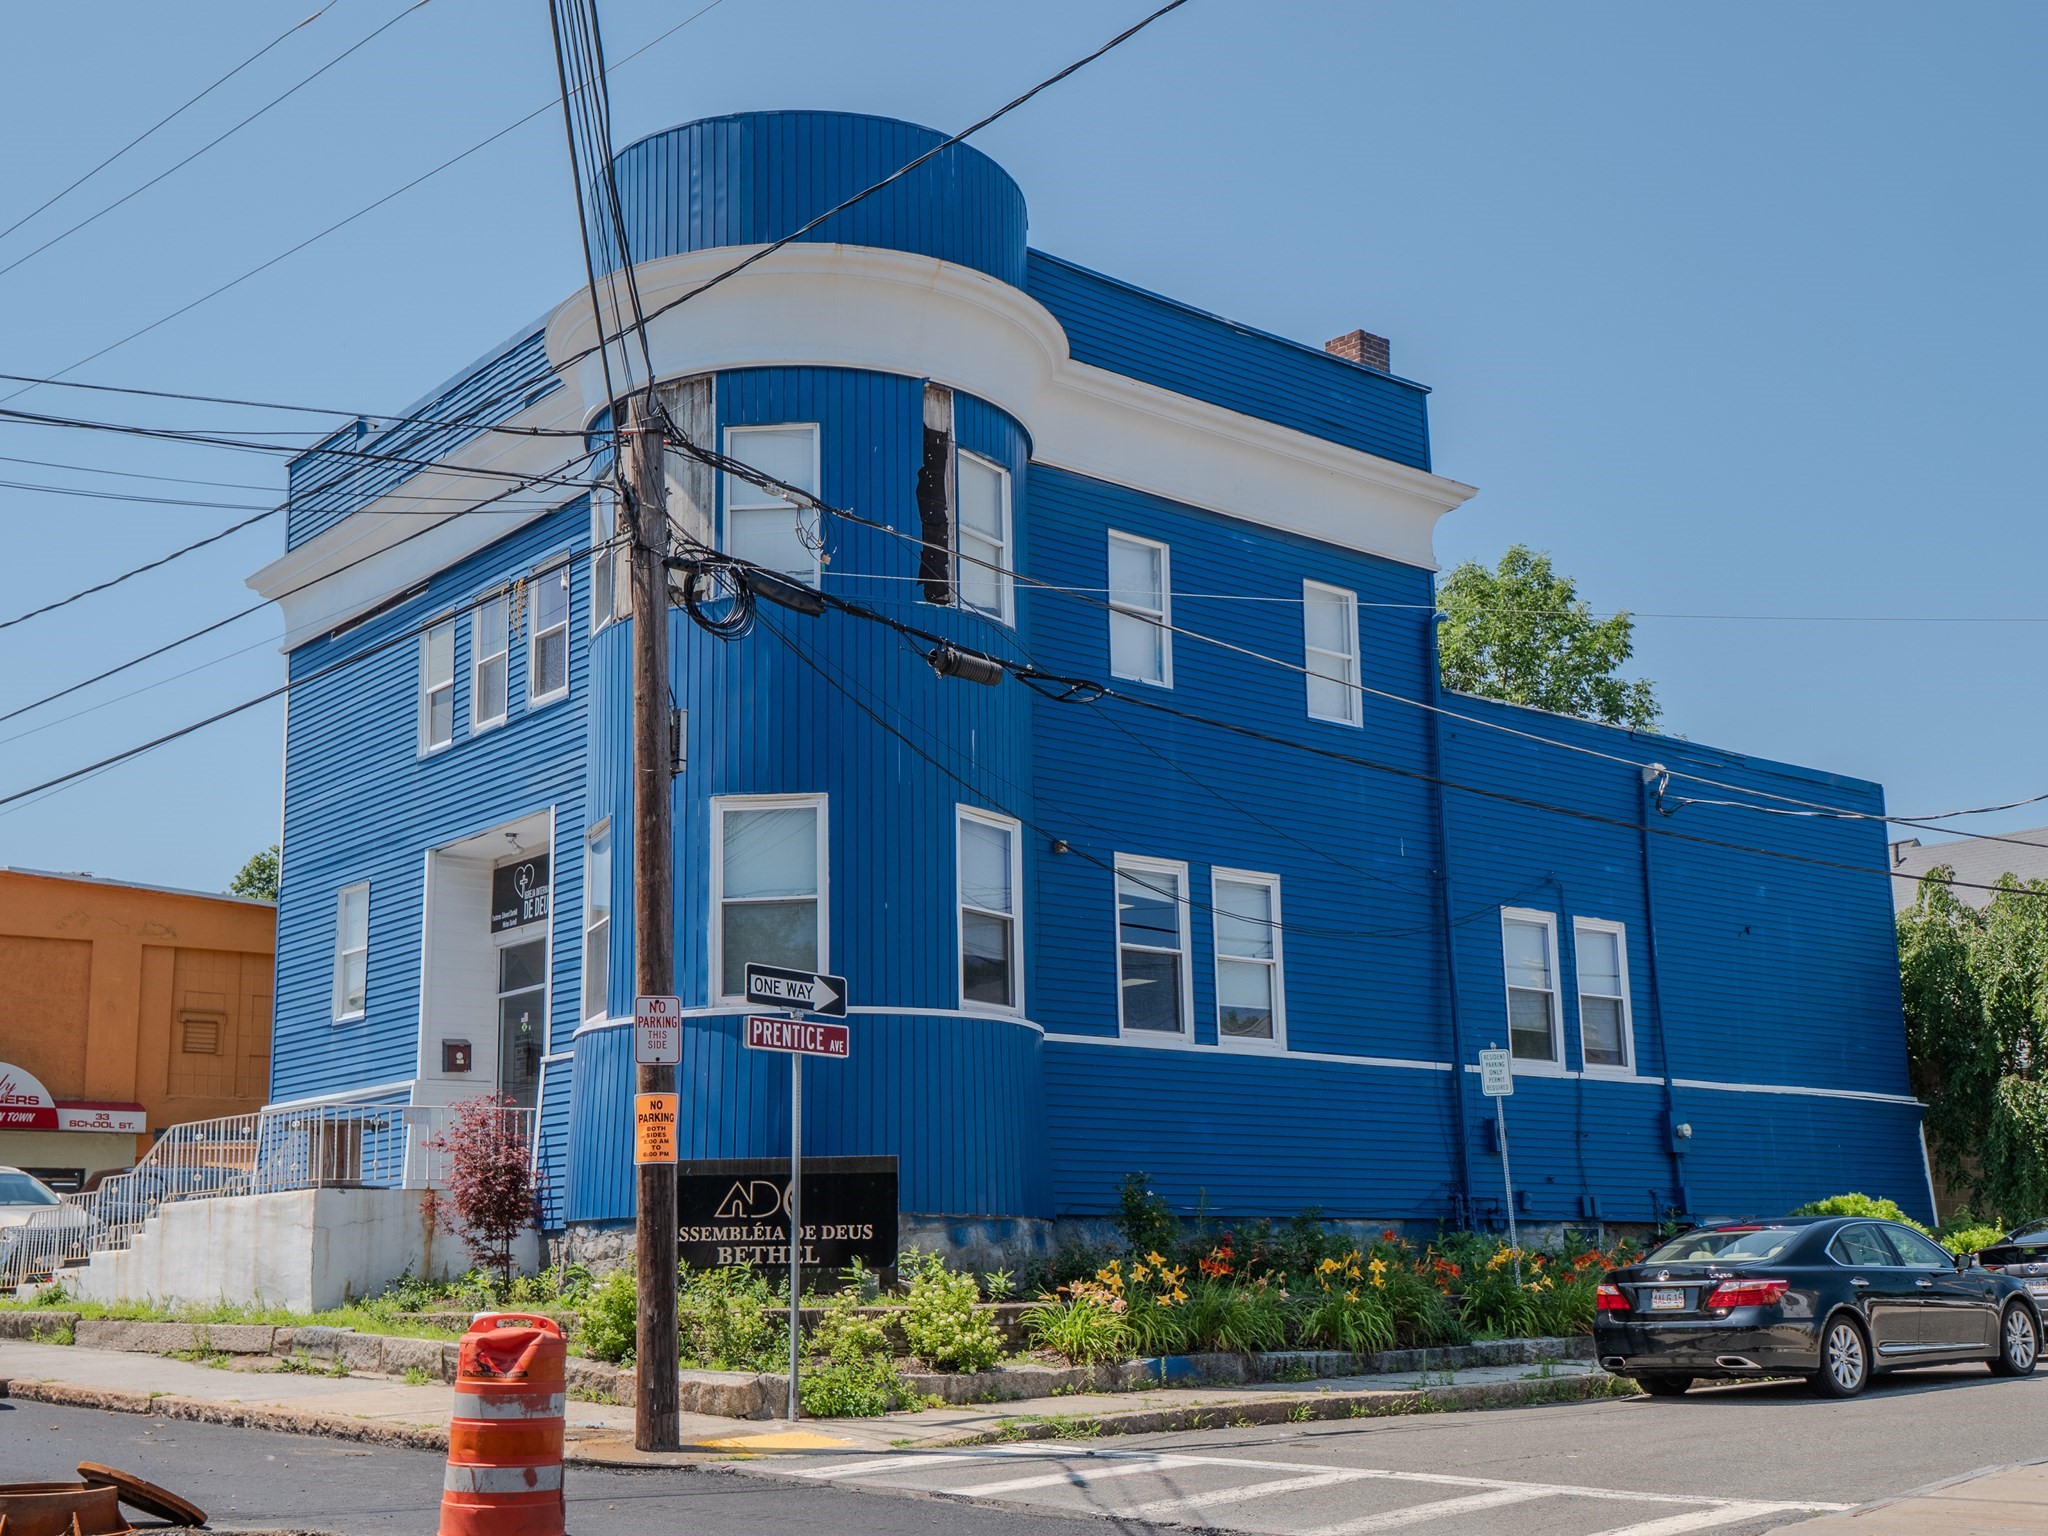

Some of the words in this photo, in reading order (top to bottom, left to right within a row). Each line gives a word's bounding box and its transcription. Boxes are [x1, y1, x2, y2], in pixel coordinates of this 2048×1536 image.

[523, 898, 534, 919] DE
[754, 977, 782, 995] ONE
[786, 982, 814, 1000] WAY
[649, 1001, 666, 1014] NO
[637, 1016, 678, 1028] PARKING
[648, 1030, 667, 1040] THIS
[753, 1020, 825, 1051] PRENTICE
[829, 1039, 845, 1053] AVE
[647, 1040, 668, 1050] SIDE
[650, 1100, 663, 1111] NO
[7, 1111, 36, 1123] TOWN
[95, 1113, 110, 1121] 33
[638, 1112, 675, 1124] PARKING
[119, 1122, 135, 1130] ST.
[678, 1222, 786, 1242] SSEMBLÉIA
[821, 1224, 873, 1240] DEUS
[716, 1245, 820, 1266] BETHL
